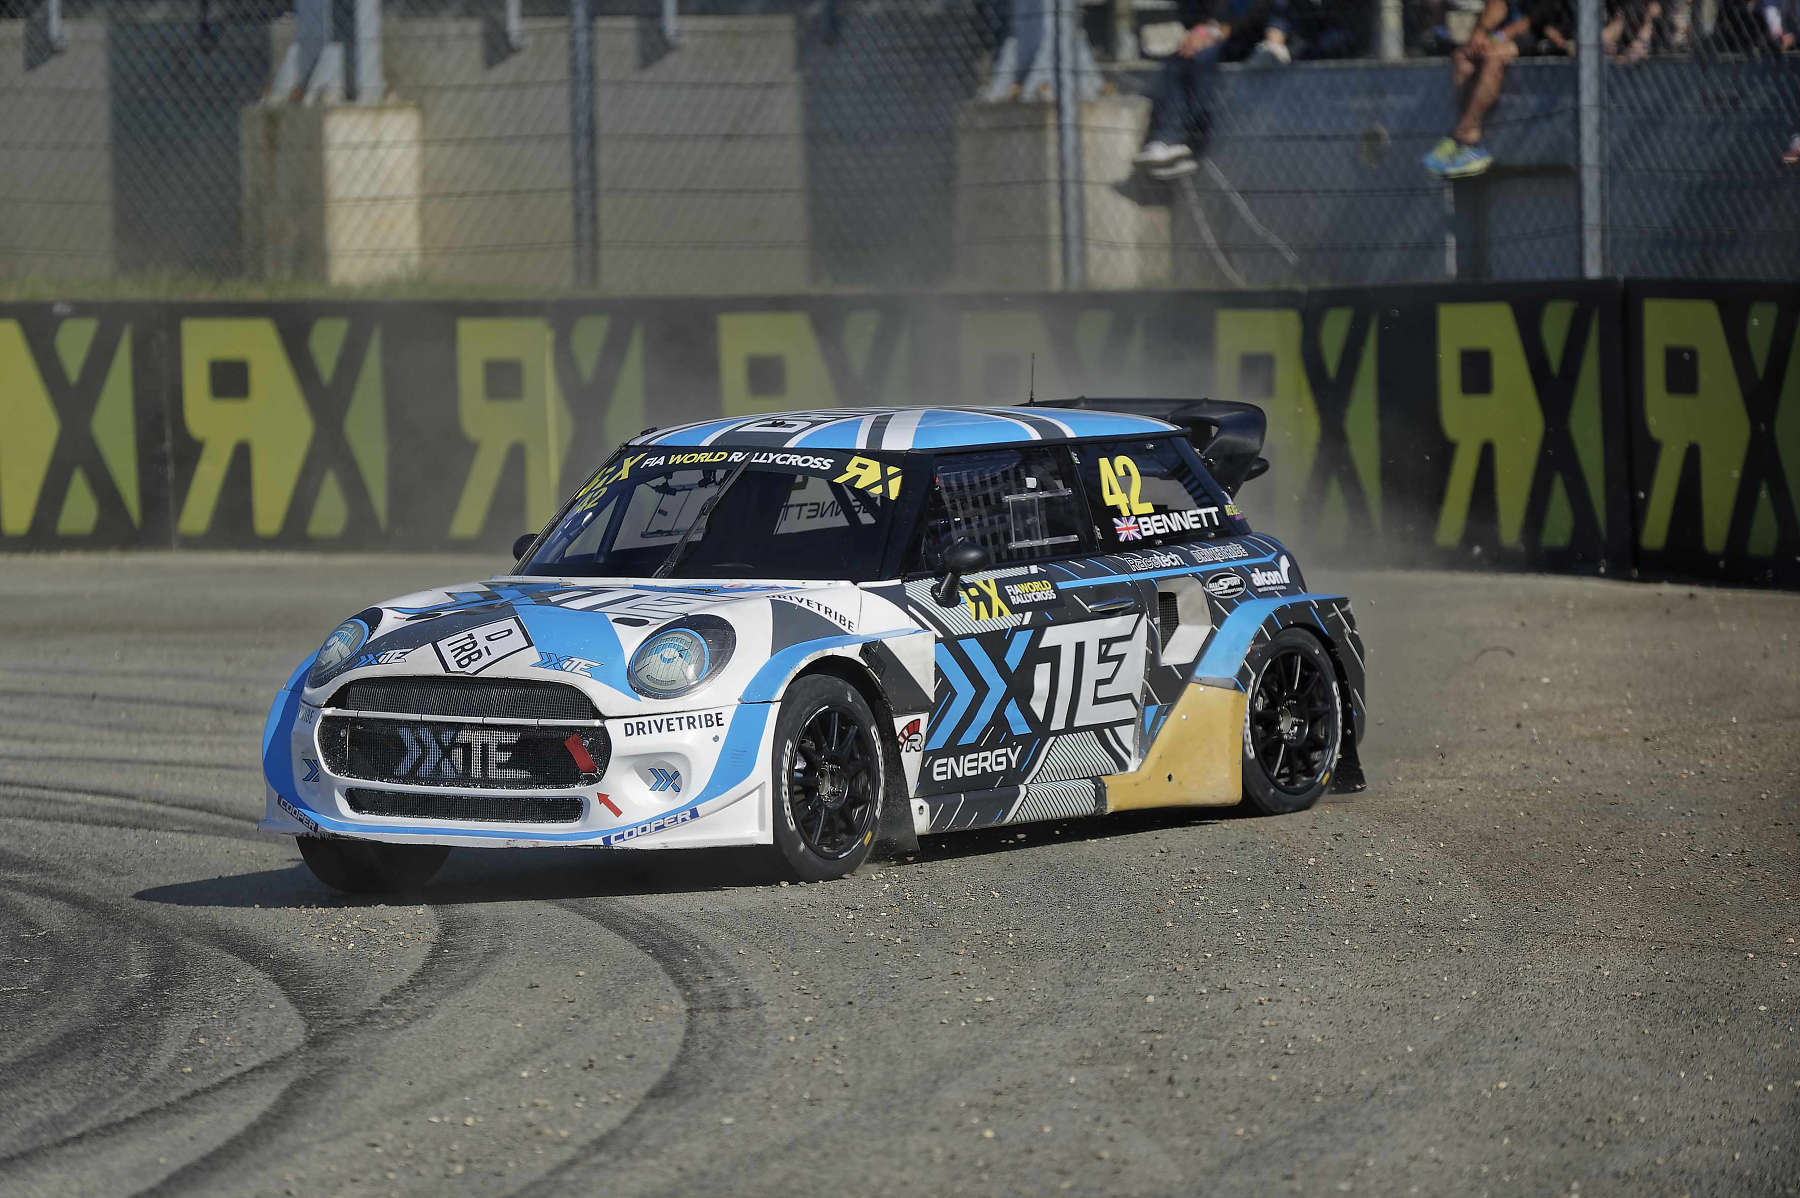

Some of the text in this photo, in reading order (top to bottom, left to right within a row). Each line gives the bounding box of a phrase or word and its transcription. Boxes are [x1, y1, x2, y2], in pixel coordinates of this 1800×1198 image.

[640, 455, 666, 469] FIA
[668, 451, 728, 465] WORLD
[1098, 455, 1155, 517] 42
[1137, 506, 1219, 537] BENNETT
[1250, 568, 1286, 588] alcon
[1009, 589, 1057, 605] RALLYCROSS
[624, 712, 725, 737] DRIVETRIBE
[932, 745, 1023, 782] ENERGY
[280, 798, 318, 832] COOPER
[609, 811, 692, 844] COOPER
